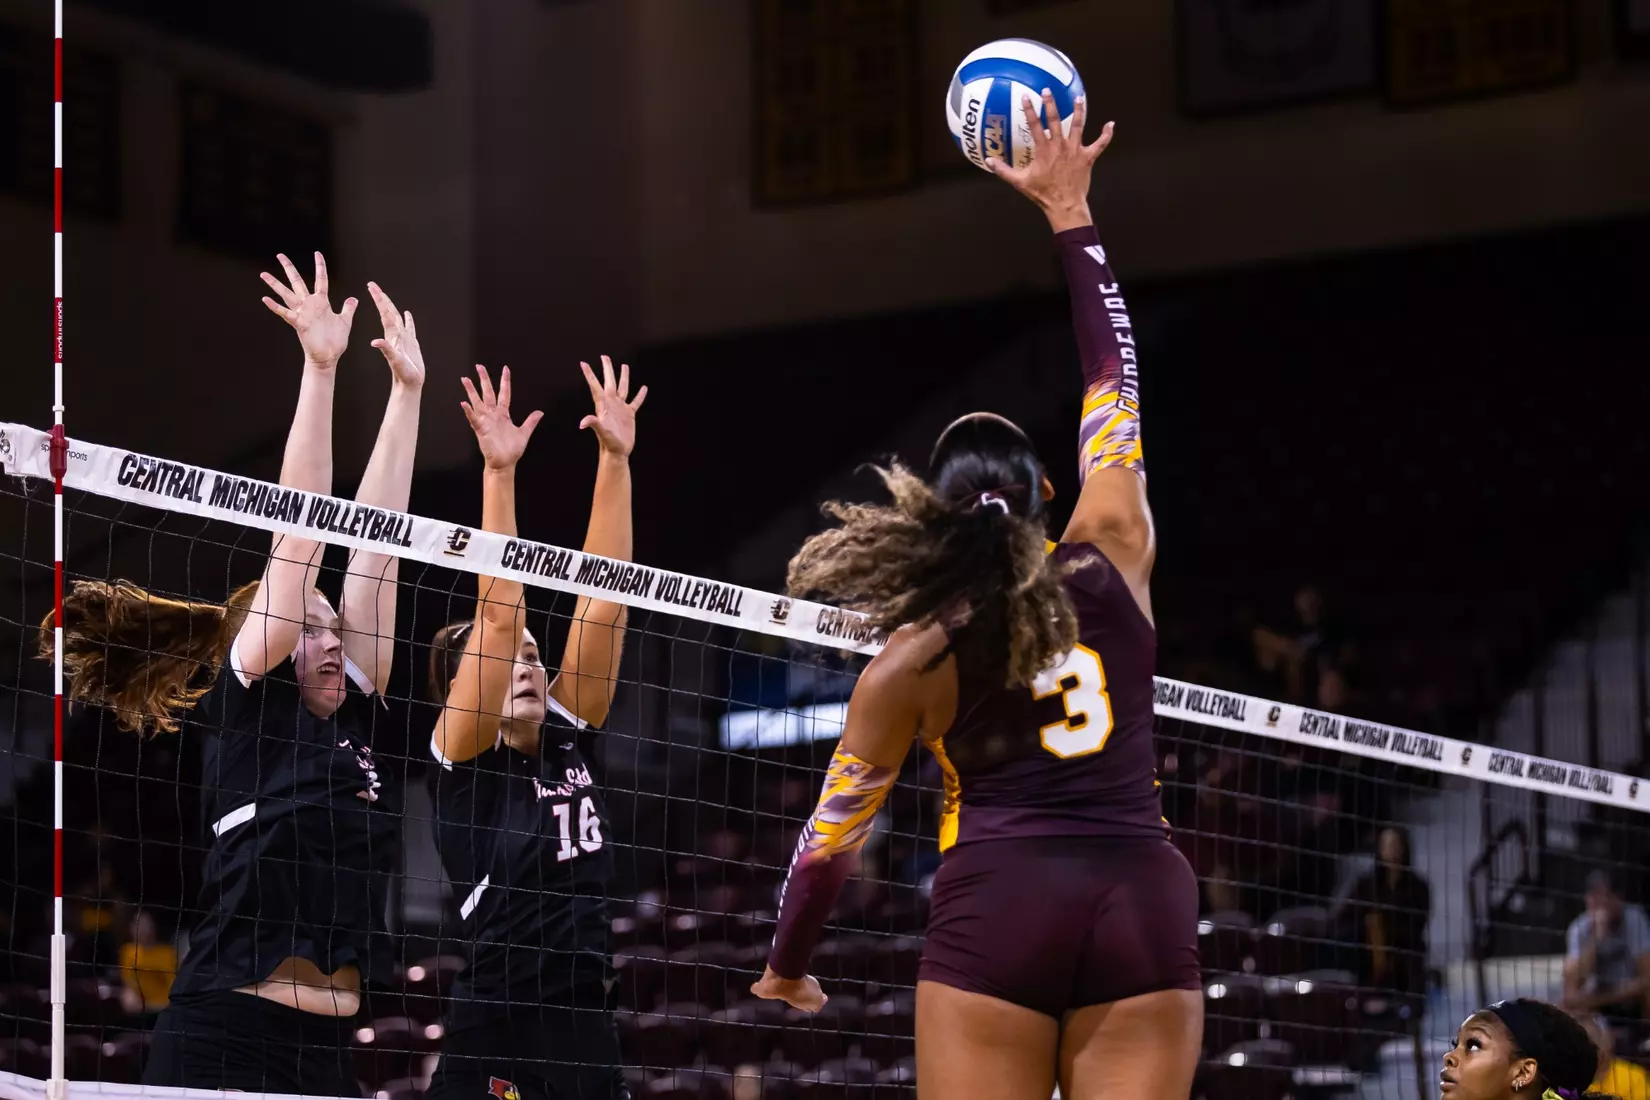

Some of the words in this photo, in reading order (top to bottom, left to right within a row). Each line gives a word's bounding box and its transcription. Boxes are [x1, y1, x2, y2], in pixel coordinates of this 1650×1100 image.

[962, 98, 984, 166] molten
[117, 454, 203, 504] CENTRAL
[208, 474, 303, 525] MICHIGAN
[305, 496, 413, 547] VOLLEYBALL
[501, 539, 573, 582] CENTRAL
[574, 559, 655, 599] MICHIGAN
[655, 572, 744, 616] VOLLEYBALL
[1030, 642, 1115, 759] 3
[1185, 689, 1246, 722] VOLLEYBALL
[1299, 712, 1342, 740] CENTRAL
[1343, 722, 1390, 750] MICHIGAN
[1390, 731, 1445, 761] VOLLEYBALL
[1487, 752, 1526, 779] CENTRAL
[1526, 760, 1567, 785] MICHIGAN
[1567, 768, 1614, 795] VOLLEYBALL
[552, 796, 602, 862] 16
